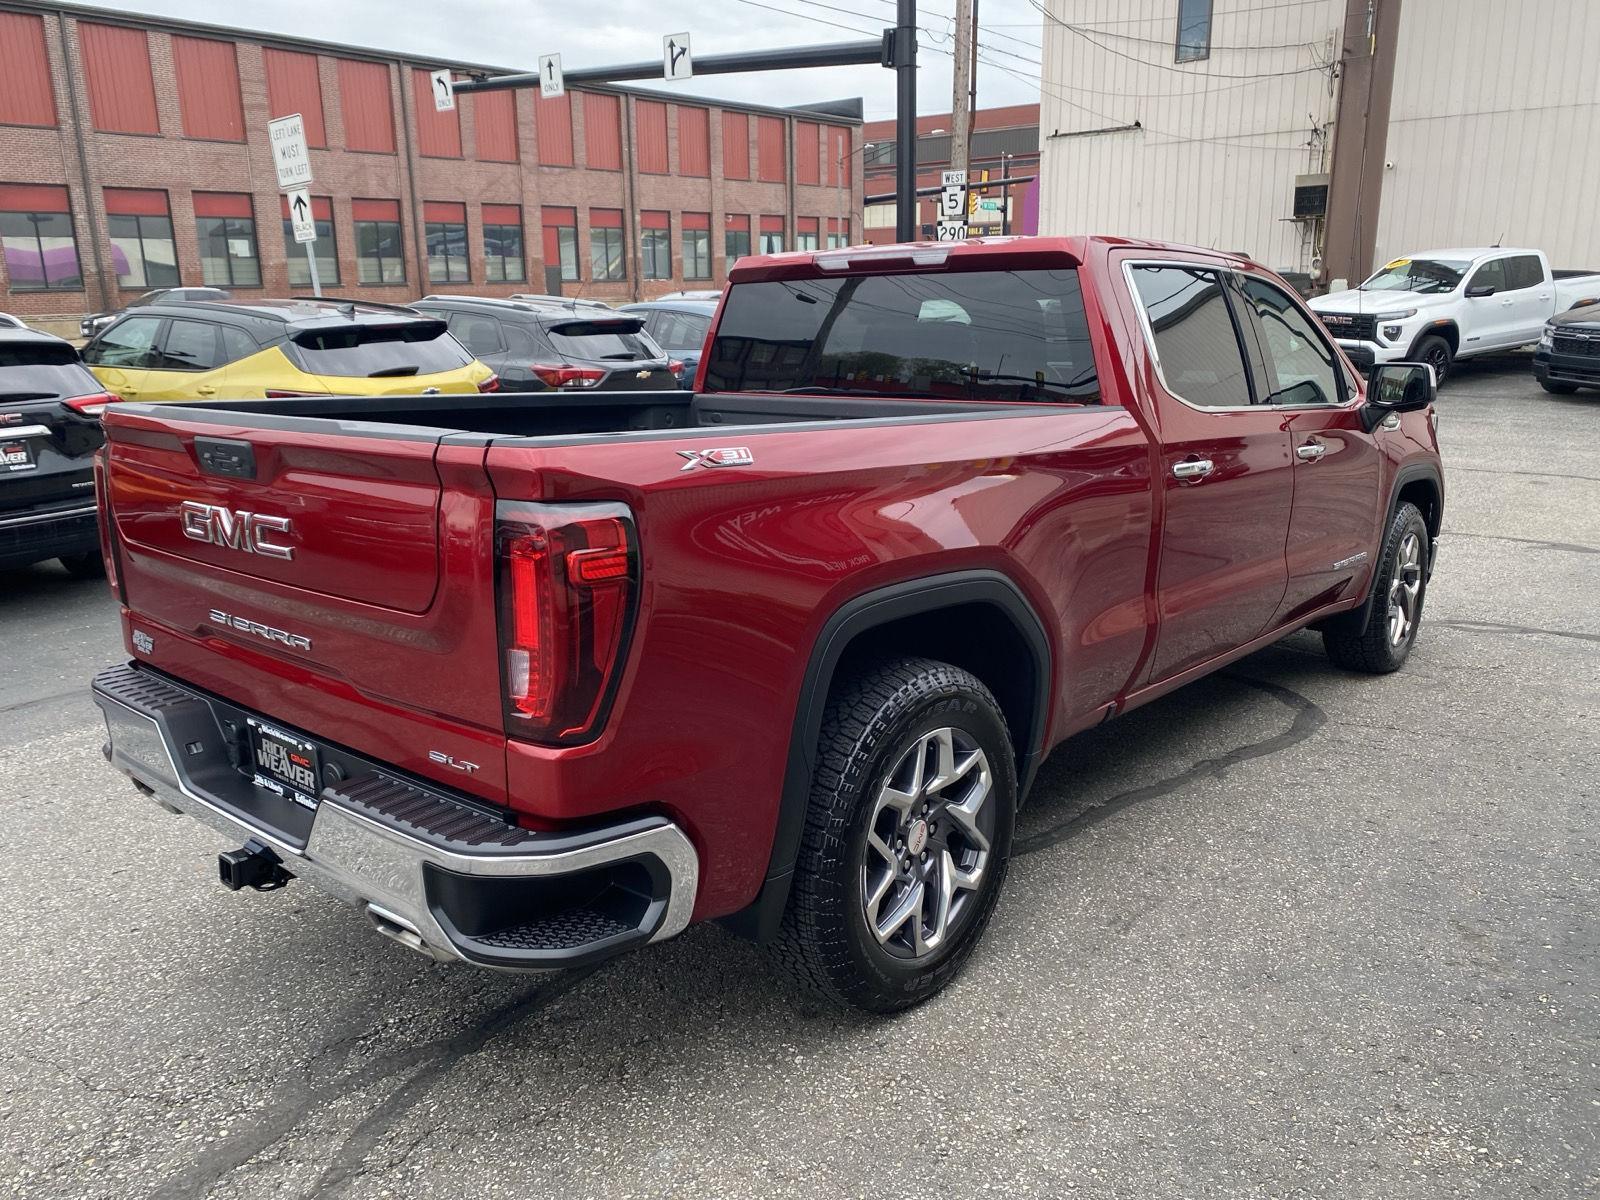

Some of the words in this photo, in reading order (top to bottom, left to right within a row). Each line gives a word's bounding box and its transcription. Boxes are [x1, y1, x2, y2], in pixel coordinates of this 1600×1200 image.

[544, 82, 560, 92] ONLY
[272, 128, 285, 141] LEFT
[286, 125, 301, 138] LANE
[280, 144, 299, 159] MUST
[279, 167, 293, 178] TURN
[295, 163, 307, 175] LEFT
[945, 173, 963, 183] WEST
[948, 194, 958, 209] 5
[940, 226, 965, 240] 290
[1322, 315, 1353, 325] GMC
[180, 500, 297, 561] GMC
[208, 608, 313, 652] SIERRA
[261, 738, 288, 760] RICK
[290, 753, 311, 768] GMC
[429, 750, 480, 773] SLT
[257, 748, 316, 789] WEAVER
